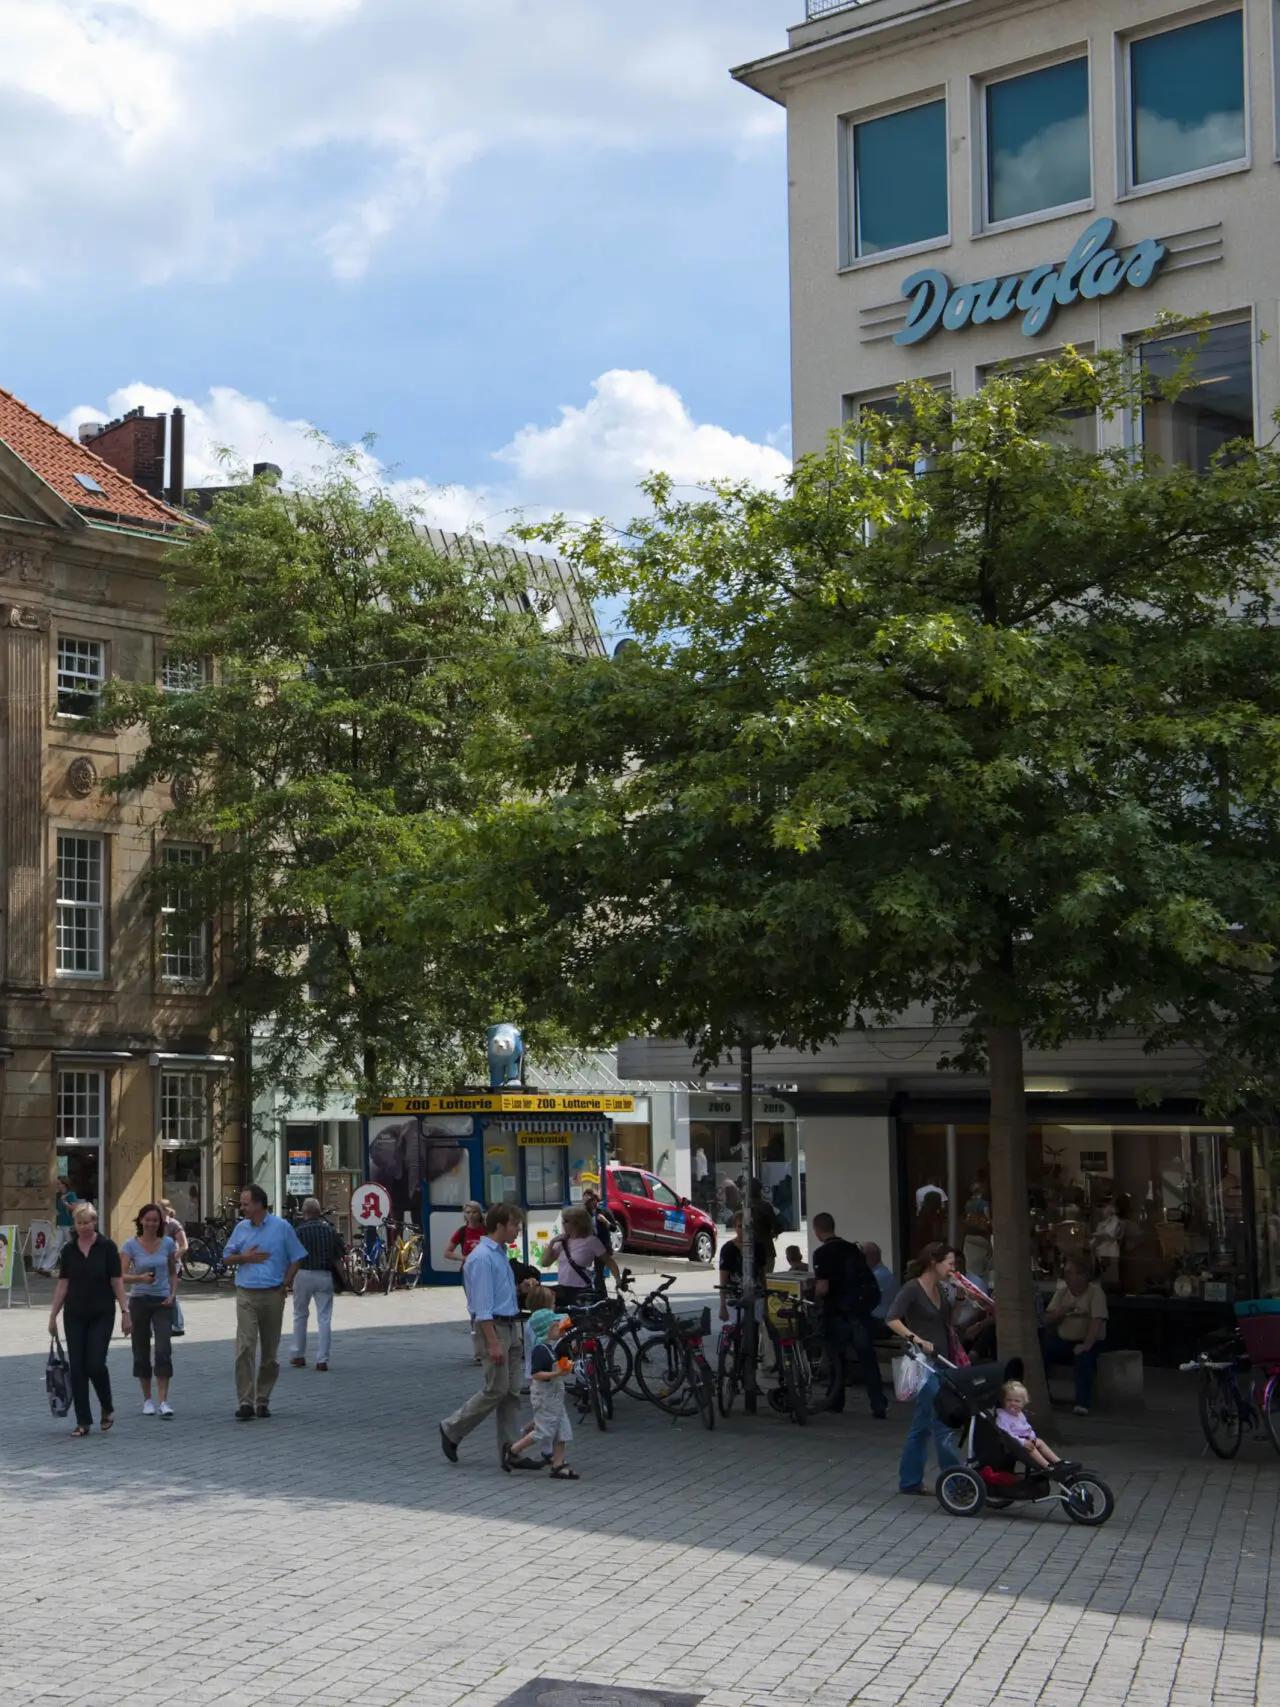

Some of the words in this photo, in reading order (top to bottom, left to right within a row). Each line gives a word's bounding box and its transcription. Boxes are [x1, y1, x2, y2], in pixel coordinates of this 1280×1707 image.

[894, 216, 1170, 346] Douglas
[405, 1100, 430, 1111] ZOO
[439, 1098, 492, 1110] Lotterie
[537, 1098, 556, 1109] ZOO
[563, 1098, 601, 1110] Lotterie
